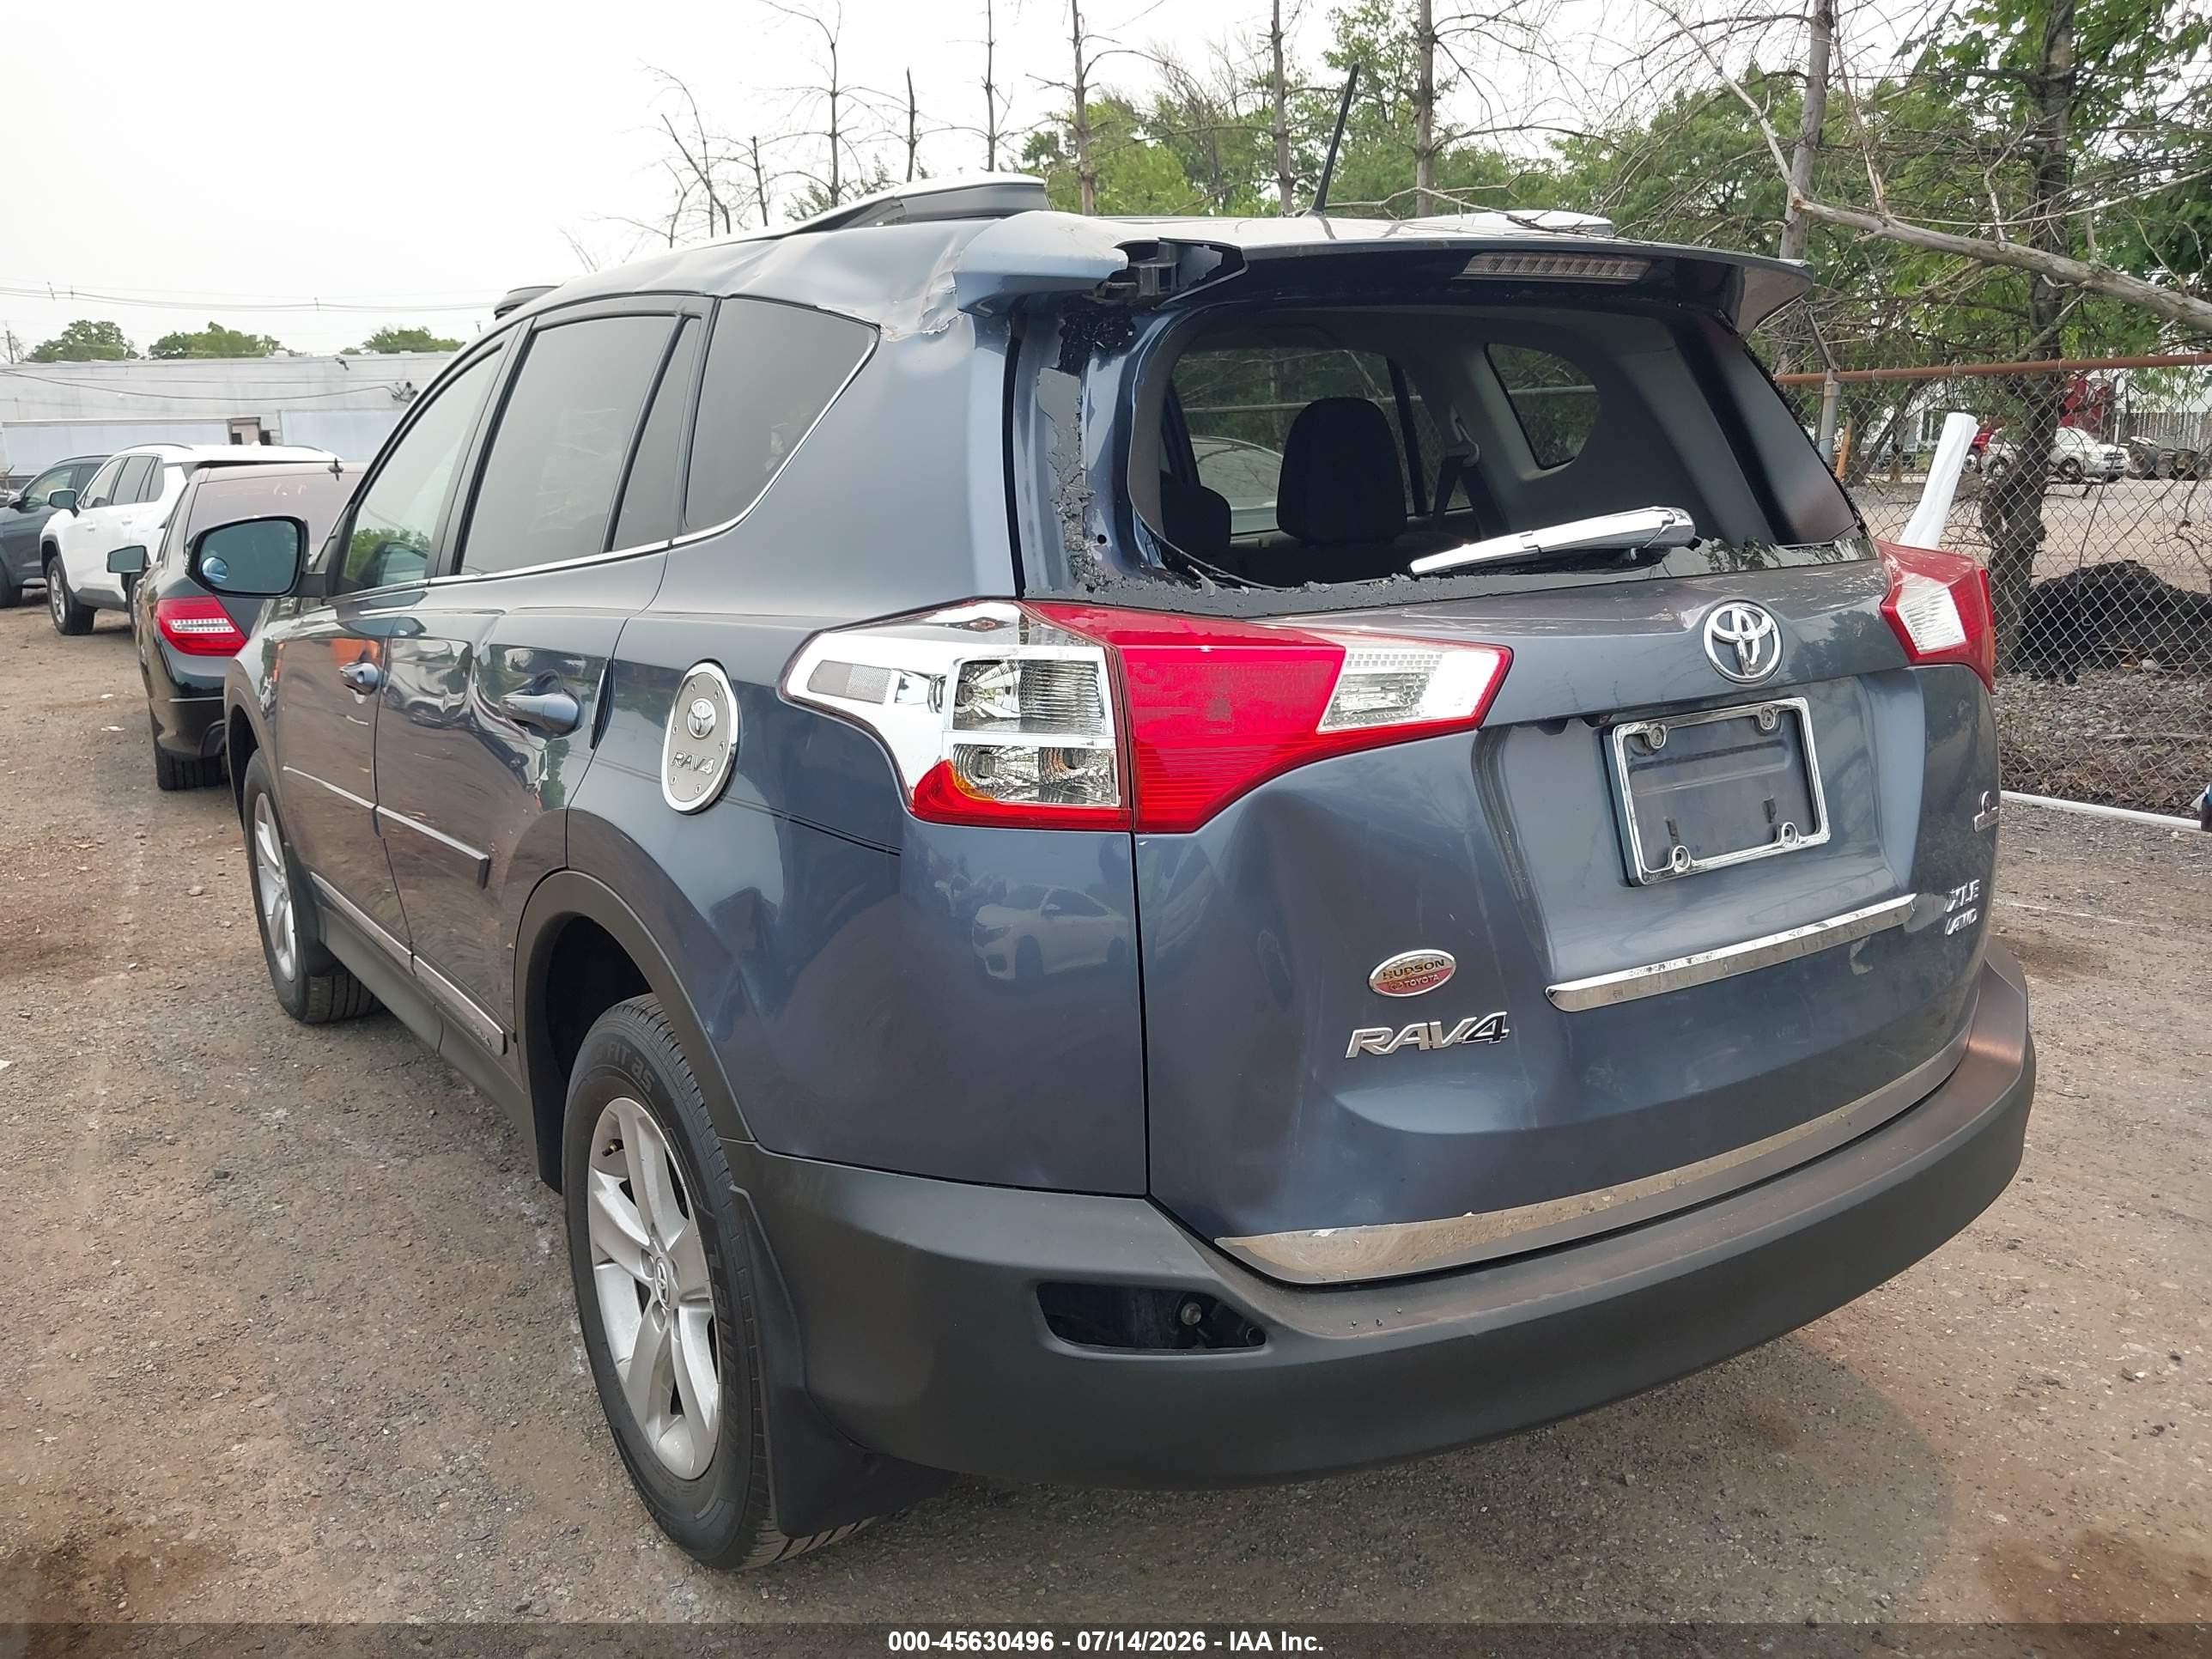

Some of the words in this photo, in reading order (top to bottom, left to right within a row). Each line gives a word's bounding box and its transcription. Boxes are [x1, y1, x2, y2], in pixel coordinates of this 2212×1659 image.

[671, 751, 715, 775] RAV4
[1382, 959, 1445, 981] HUDSON
[1404, 974, 1440, 988] TOYOTA
[1345, 1011, 1511, 1059] RAV4
